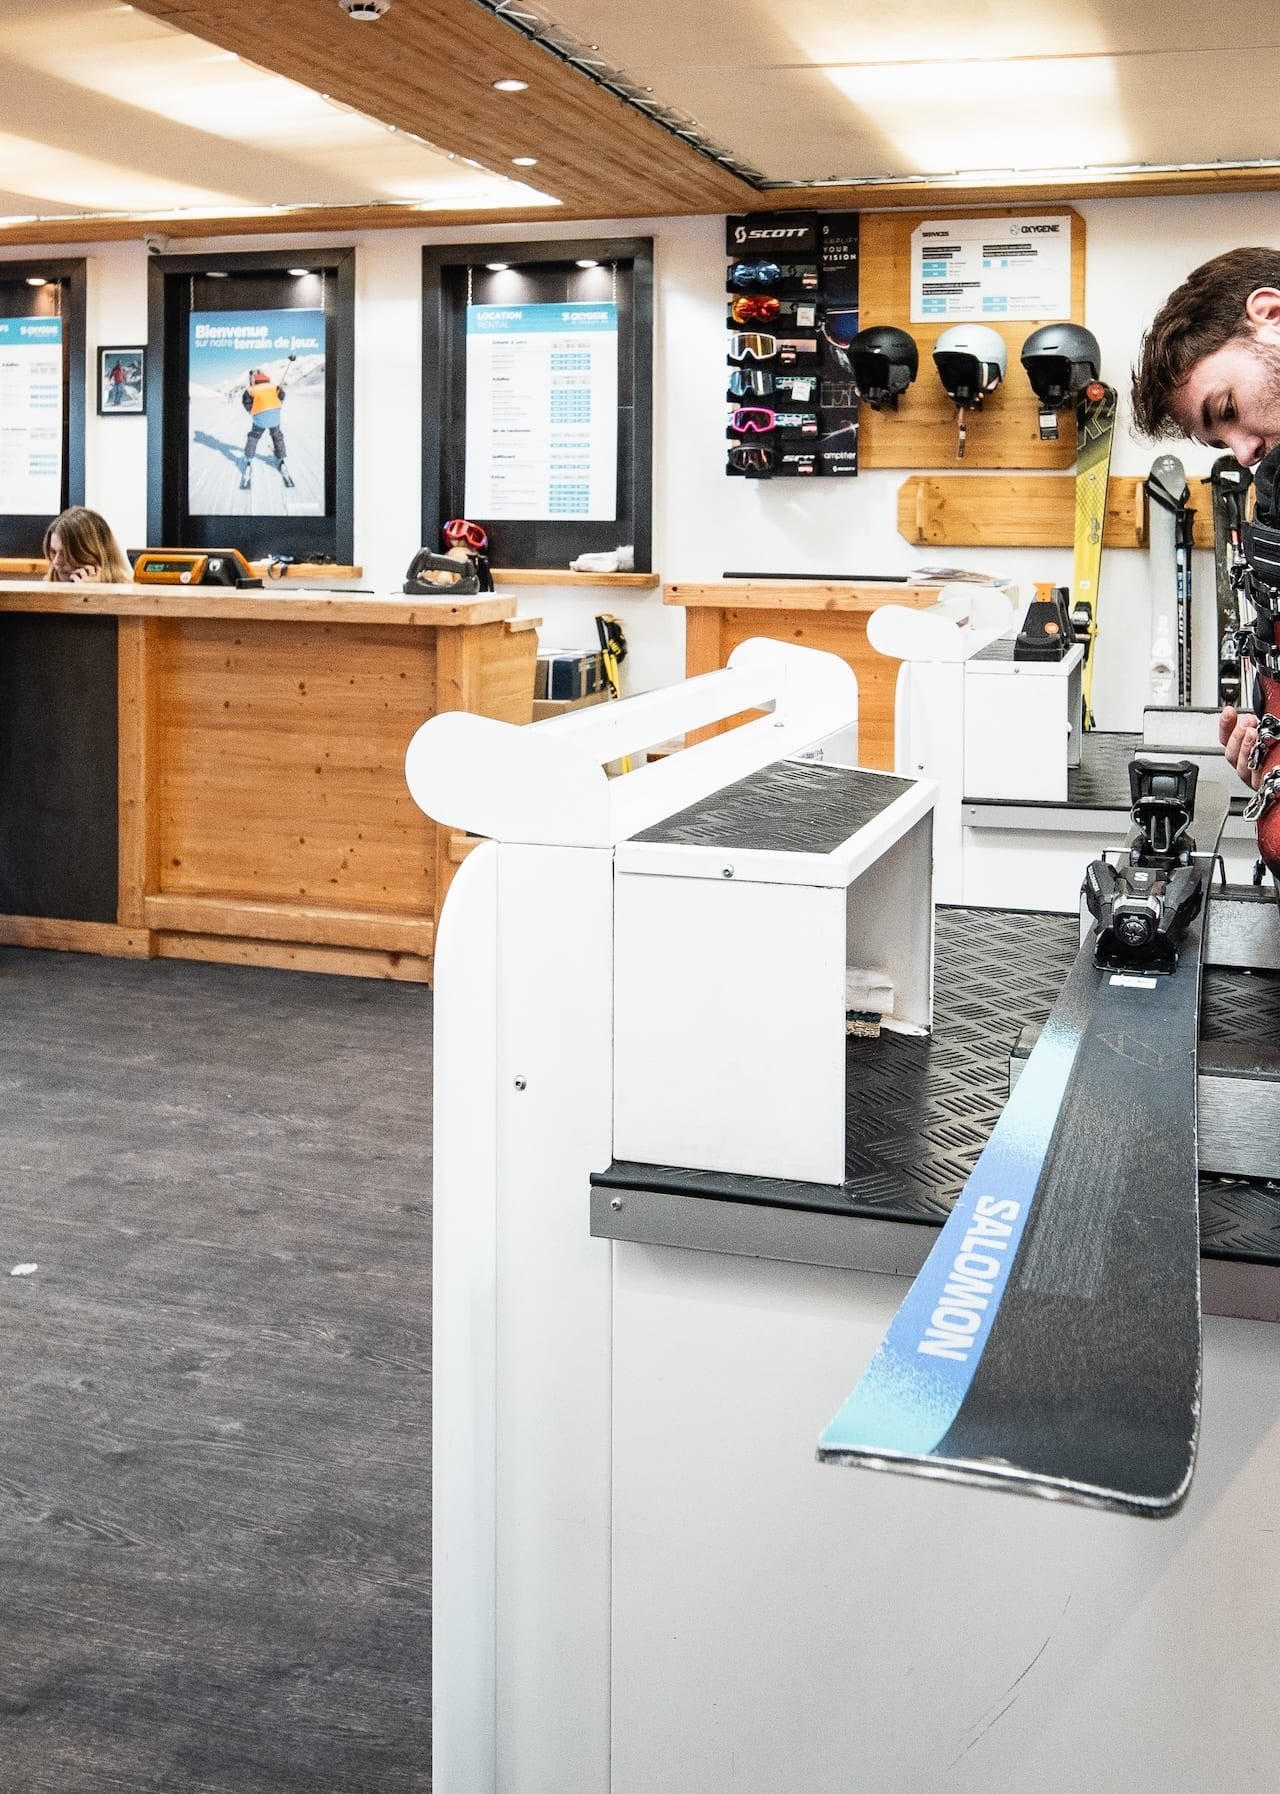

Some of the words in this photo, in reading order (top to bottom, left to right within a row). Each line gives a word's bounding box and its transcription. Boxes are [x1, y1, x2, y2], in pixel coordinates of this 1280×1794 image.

[748, 228, 809, 239] SCOTT
[1021, 225, 1060, 234] OXYGENE
[823, 245, 849, 253] YOUR
[477, 311, 522, 321] LOCATION
[195, 324, 268, 339] Bienvenue
[195, 340, 209, 348] sur
[210, 339, 232, 347] notre
[234, 338, 273, 349] terrain
[274, 337, 289, 349] de
[290, 335, 319, 350] jeux.
[823, 451, 857, 461] amplifier
[1088, 865, 1100, 892] SALOMON
[917, 1194, 1020, 1362] SALOMON
